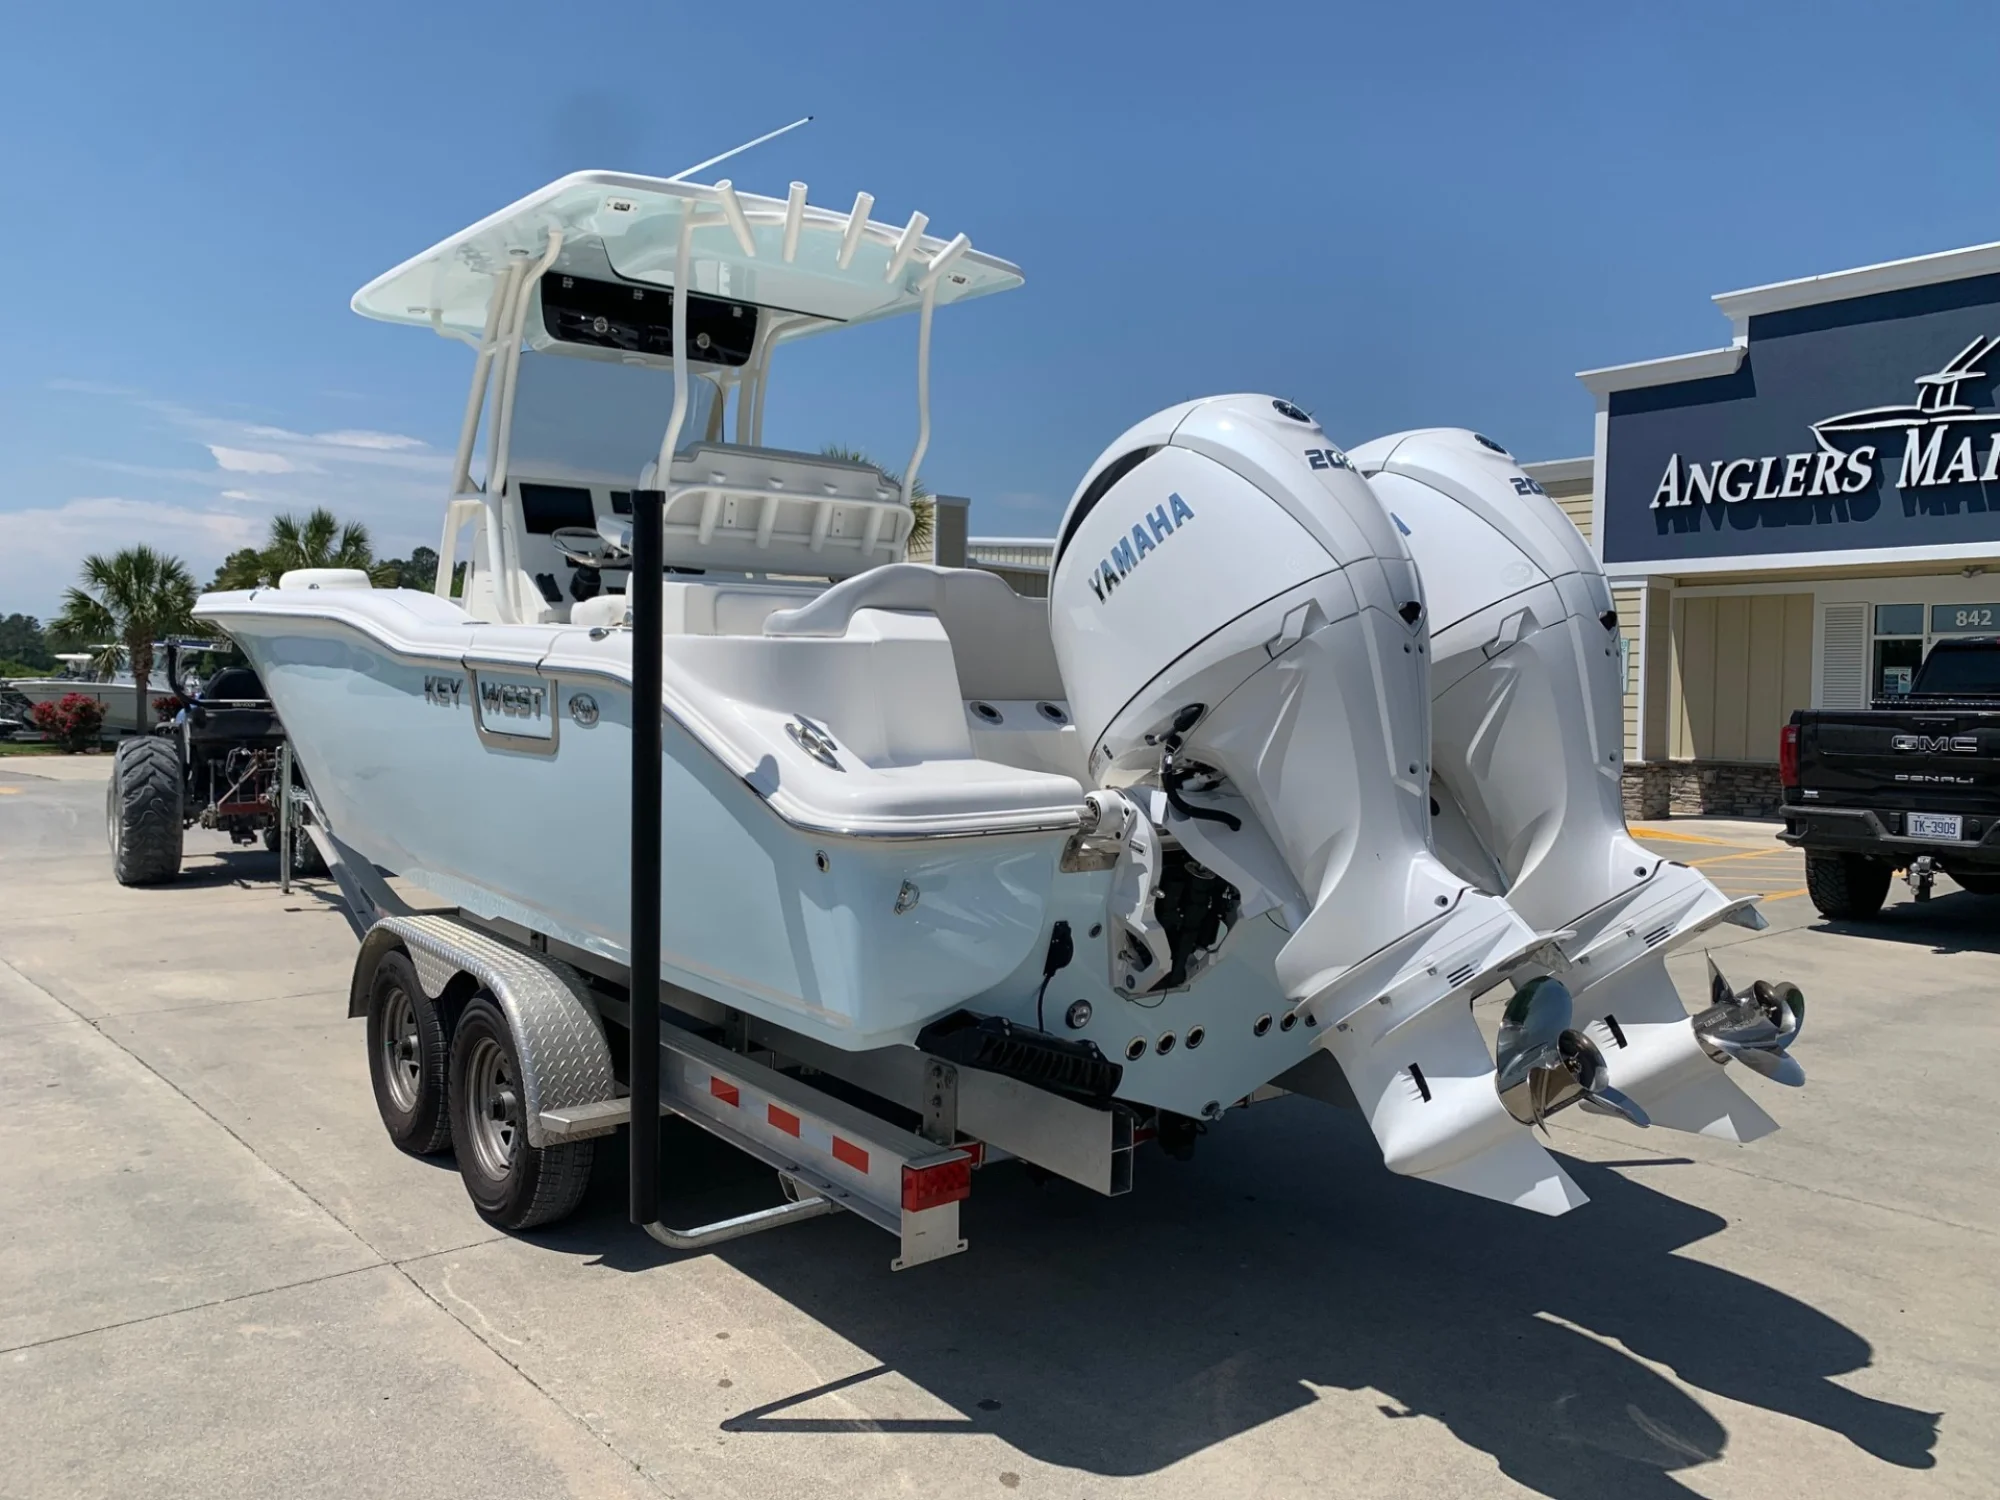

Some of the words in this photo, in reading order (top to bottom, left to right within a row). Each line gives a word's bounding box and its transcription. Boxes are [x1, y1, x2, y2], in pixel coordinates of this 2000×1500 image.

[1649, 446, 1876, 508] ANGLERS
[1087, 492, 1195, 605] YAMAHA
[1956, 609, 1992, 626] 842
[424, 675, 463, 709] KEY
[481, 681, 545, 721] WEST
[1891, 735, 1977, 752] GMC
[1894, 774, 1974, 783] DENALI
[1913, 820, 1956, 835] TK-3909
